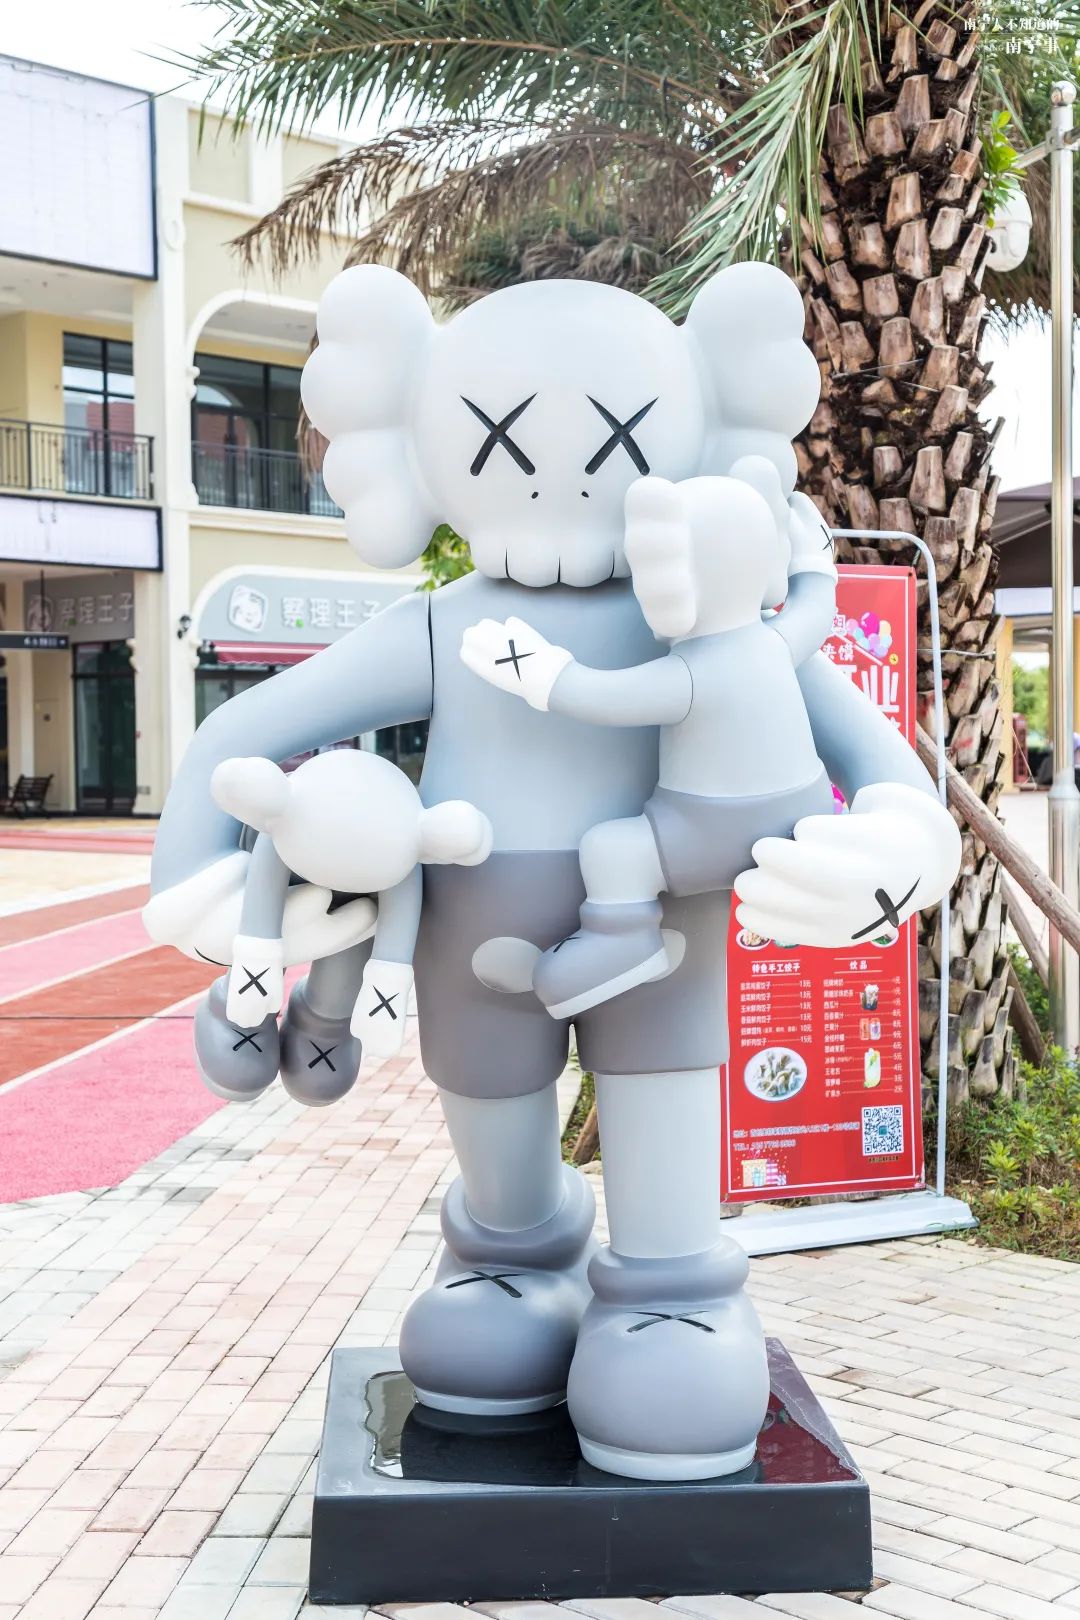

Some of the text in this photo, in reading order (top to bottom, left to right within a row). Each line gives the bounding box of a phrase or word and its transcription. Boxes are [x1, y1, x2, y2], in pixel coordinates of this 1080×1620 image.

[752, 962, 801, 974] 特色手工饺子
[849, 960, 868, 971] 饮品
